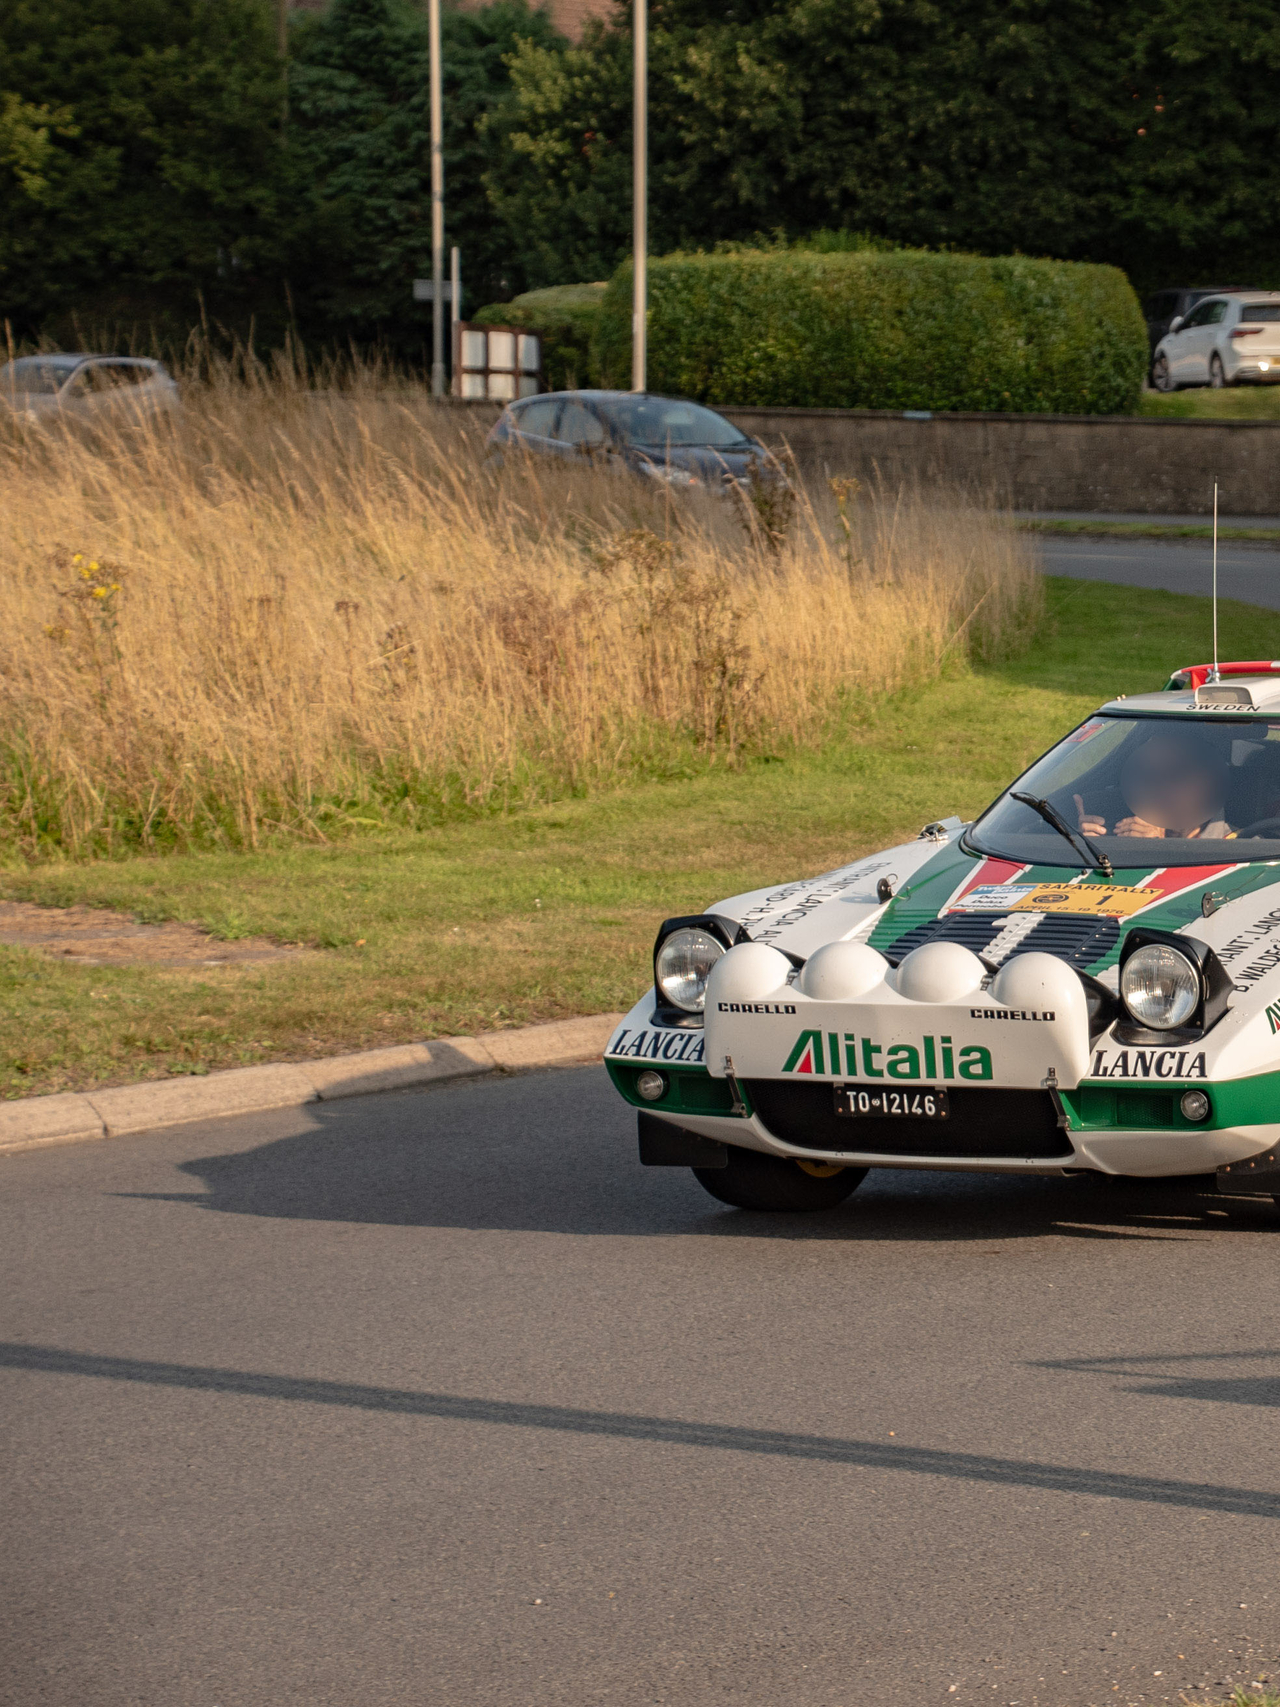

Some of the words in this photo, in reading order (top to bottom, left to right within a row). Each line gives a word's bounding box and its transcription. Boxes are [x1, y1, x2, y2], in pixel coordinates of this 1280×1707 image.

[1186, 703, 1261, 712] SWEDEN
[1039, 883, 1102, 892] SAFARI
[1103, 885, 1160, 895] RALLY
[1095, 894, 1114, 905] 1
[718, 1002, 797, 1015] CARELLO
[970, 1008, 1056, 1022] CARELLO
[609, 1029, 706, 1063] LANCIA
[781, 1029, 994, 1081] Alitalia
[1090, 1049, 1208, 1078] LANCIA
